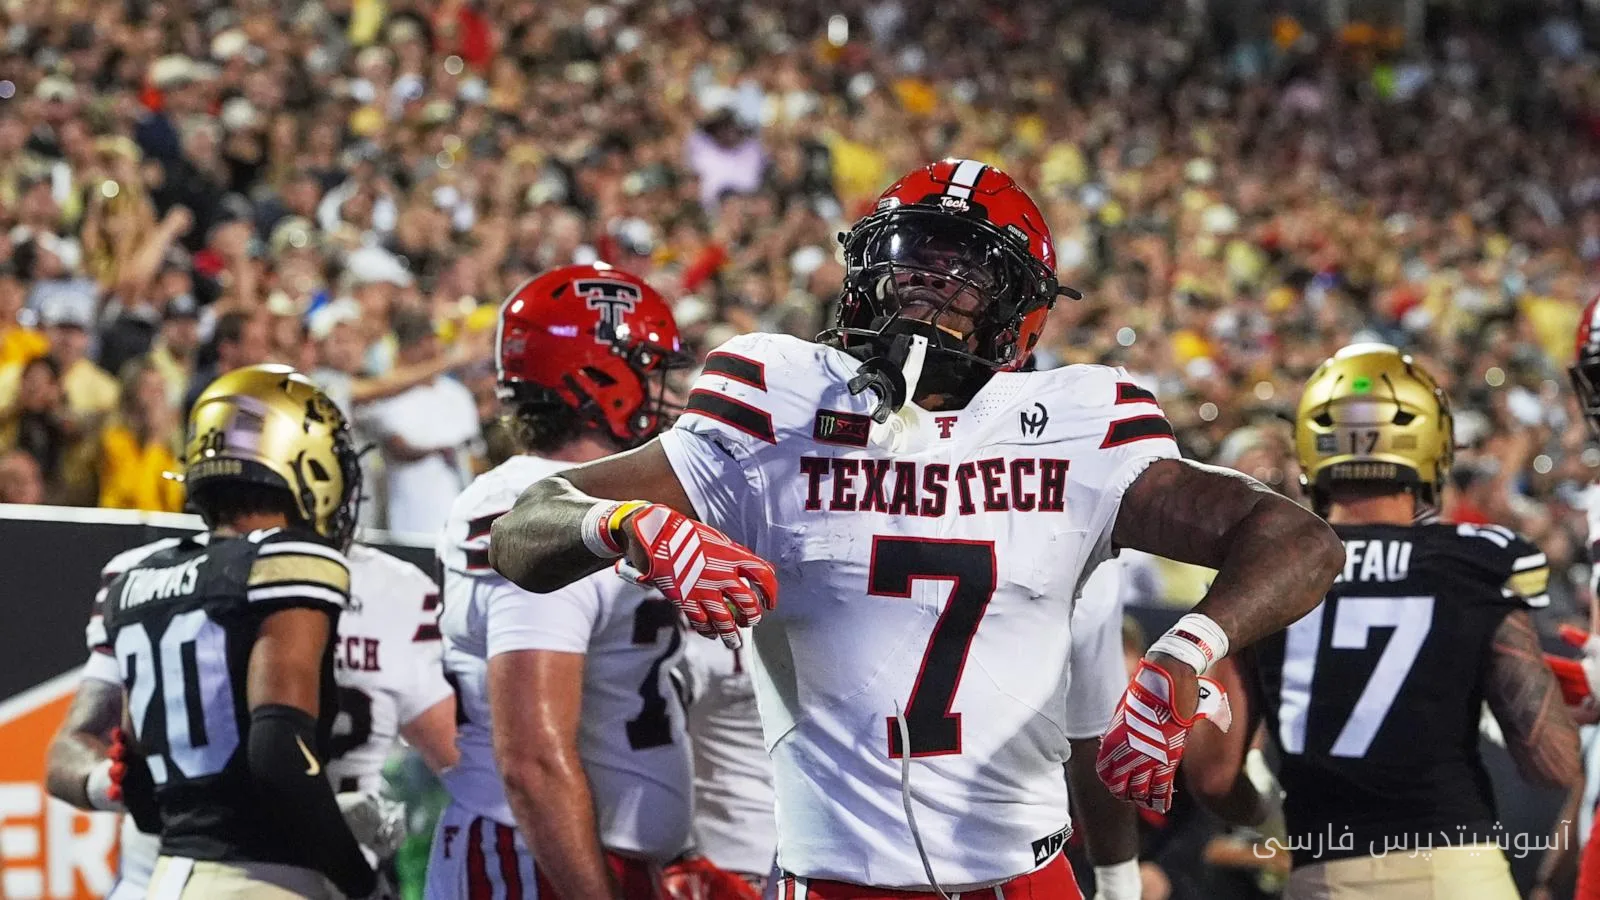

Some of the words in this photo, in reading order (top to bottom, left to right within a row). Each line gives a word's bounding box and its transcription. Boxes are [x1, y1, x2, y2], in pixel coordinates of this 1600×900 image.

[940, 196, 970, 212] Tech
[1350, 431, 1379, 455] 17
[800, 456, 951, 518] TEXAS
[955, 457, 1071, 516] TECH
[120, 554, 208, 610] THOMAS
[1335, 539, 1413, 583] FAU
[867, 535, 998, 759] 7
[1198, 640, 1214, 662] WON
[114, 610, 241, 780] 20
[1279, 596, 1436, 758] 17
